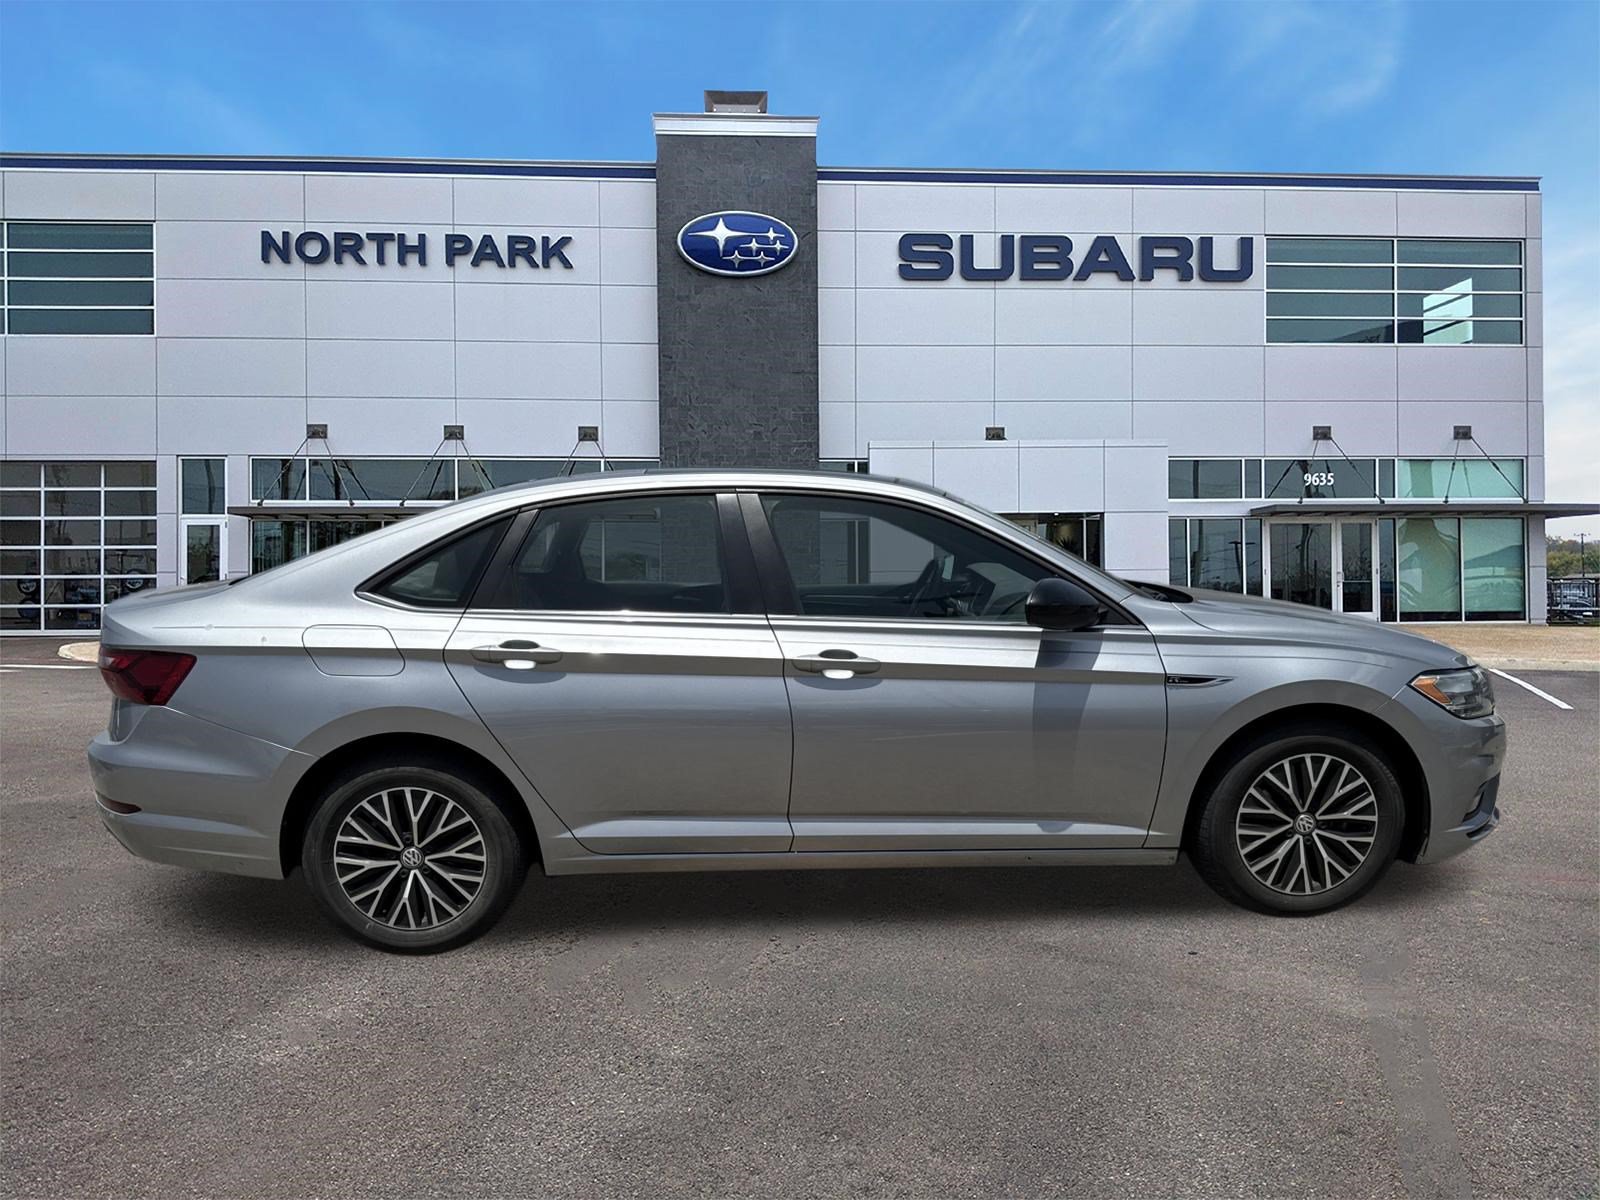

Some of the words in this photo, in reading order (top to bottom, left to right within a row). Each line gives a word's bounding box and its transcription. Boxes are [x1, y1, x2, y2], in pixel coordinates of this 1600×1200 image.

[260, 230, 427, 266] NORTH
[445, 233, 574, 269] PARK
[898, 233, 1254, 282] SUBARU
[1303, 472, 1335, 486] 9635
